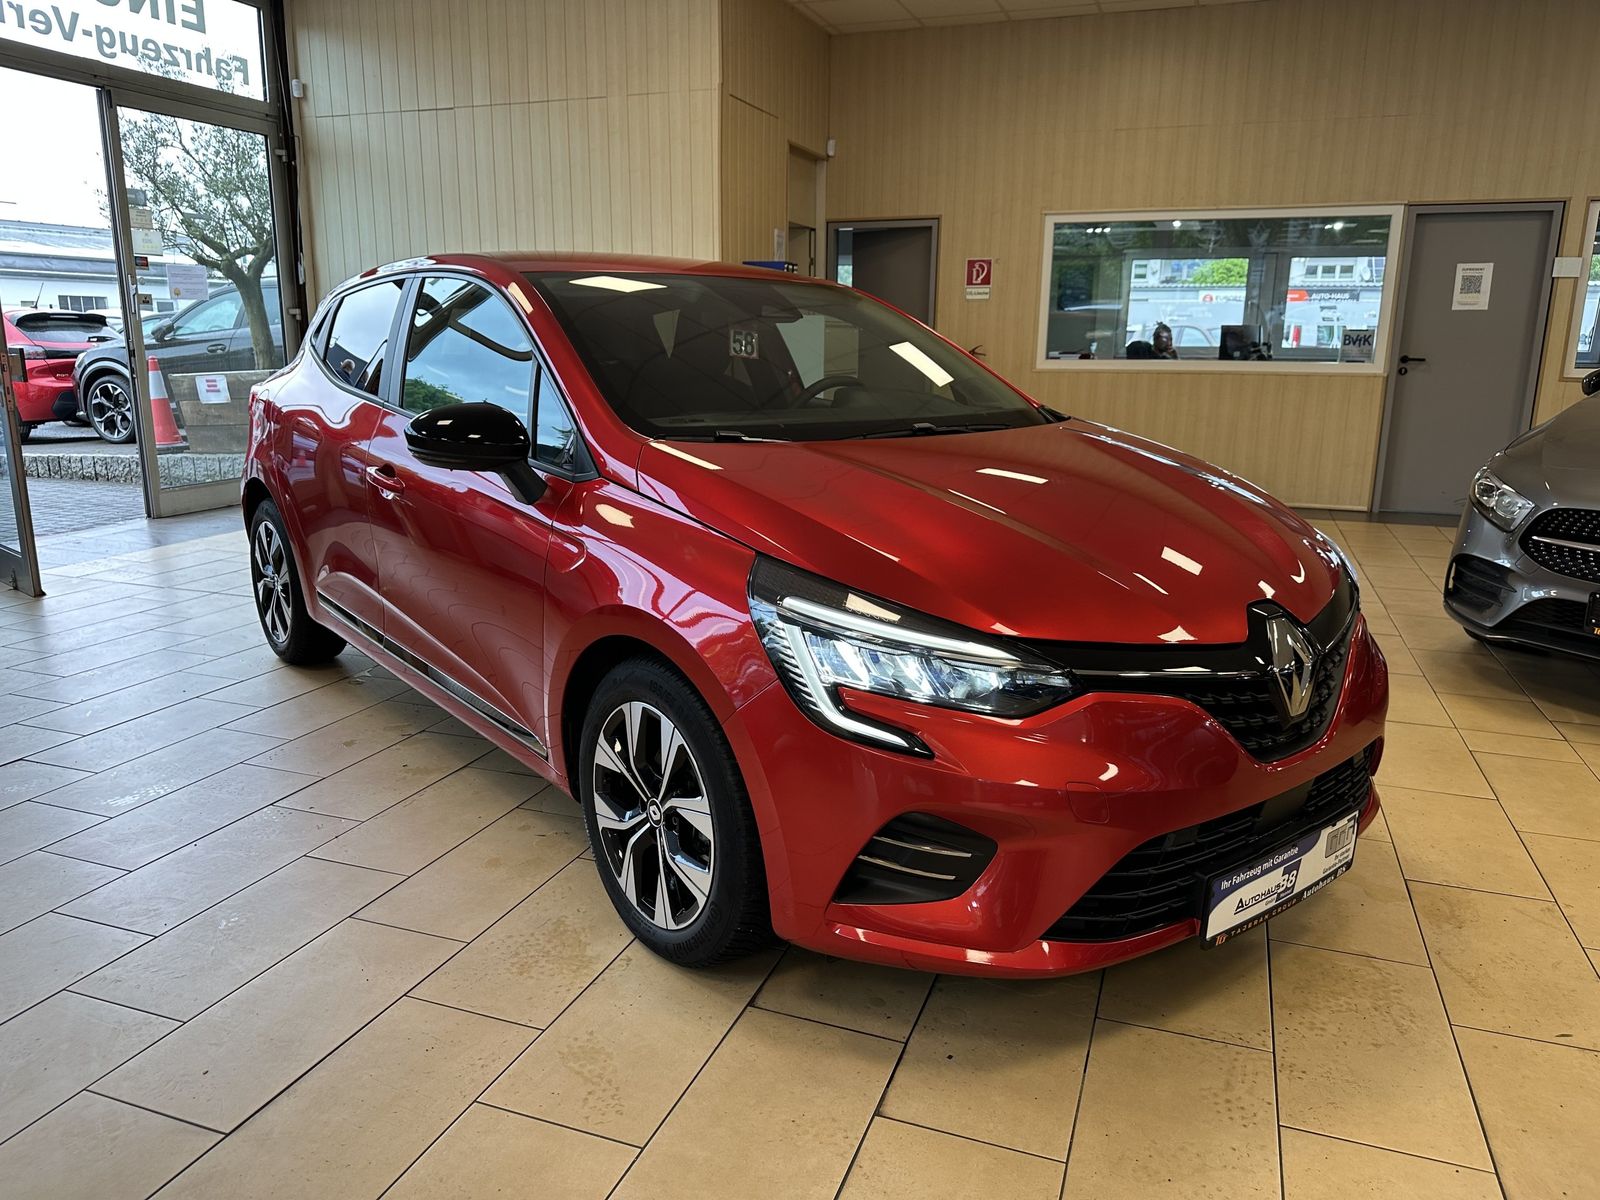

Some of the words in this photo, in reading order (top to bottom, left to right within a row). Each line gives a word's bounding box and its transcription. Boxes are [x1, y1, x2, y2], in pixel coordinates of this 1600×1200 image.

[733, 330, 755, 356] 58
[1220, 880, 1231, 891] Ihr
[1232, 865, 1262, 886] Fahrzeug
[1262, 858, 1273, 870] mit
[1273, 846, 1299, 865] Garantie
